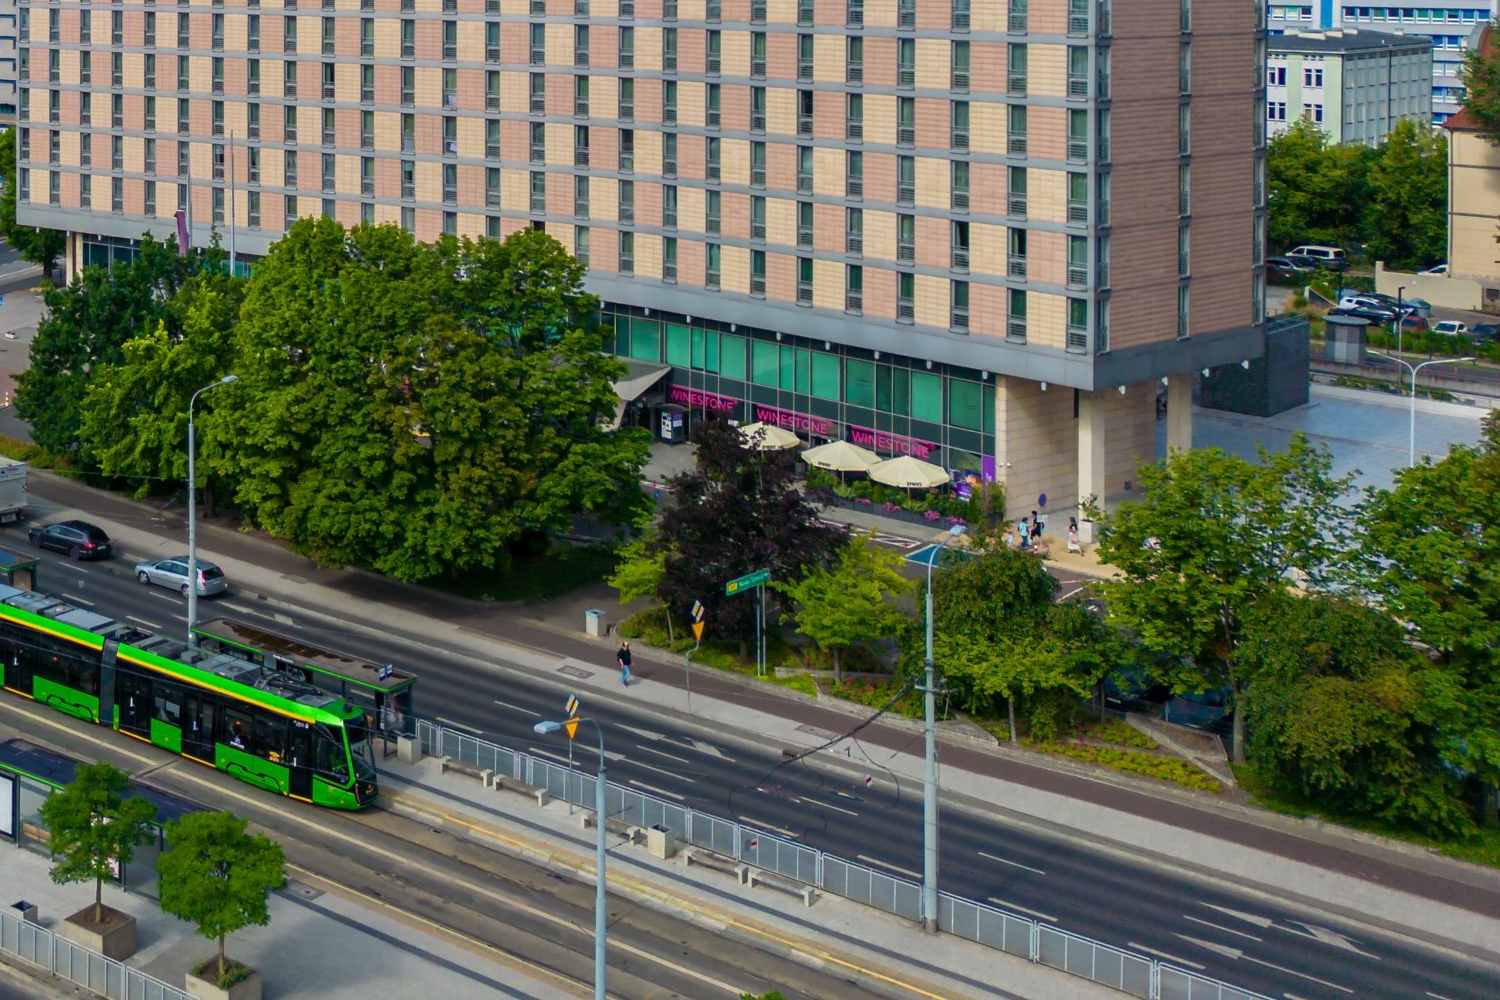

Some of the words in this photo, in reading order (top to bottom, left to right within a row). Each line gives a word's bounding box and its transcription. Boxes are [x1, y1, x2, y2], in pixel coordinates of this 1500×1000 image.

[670, 389, 734, 410] WINESTONE
[756, 408, 828, 434] WINESTONE
[851, 430, 930, 459] WINESTONE
